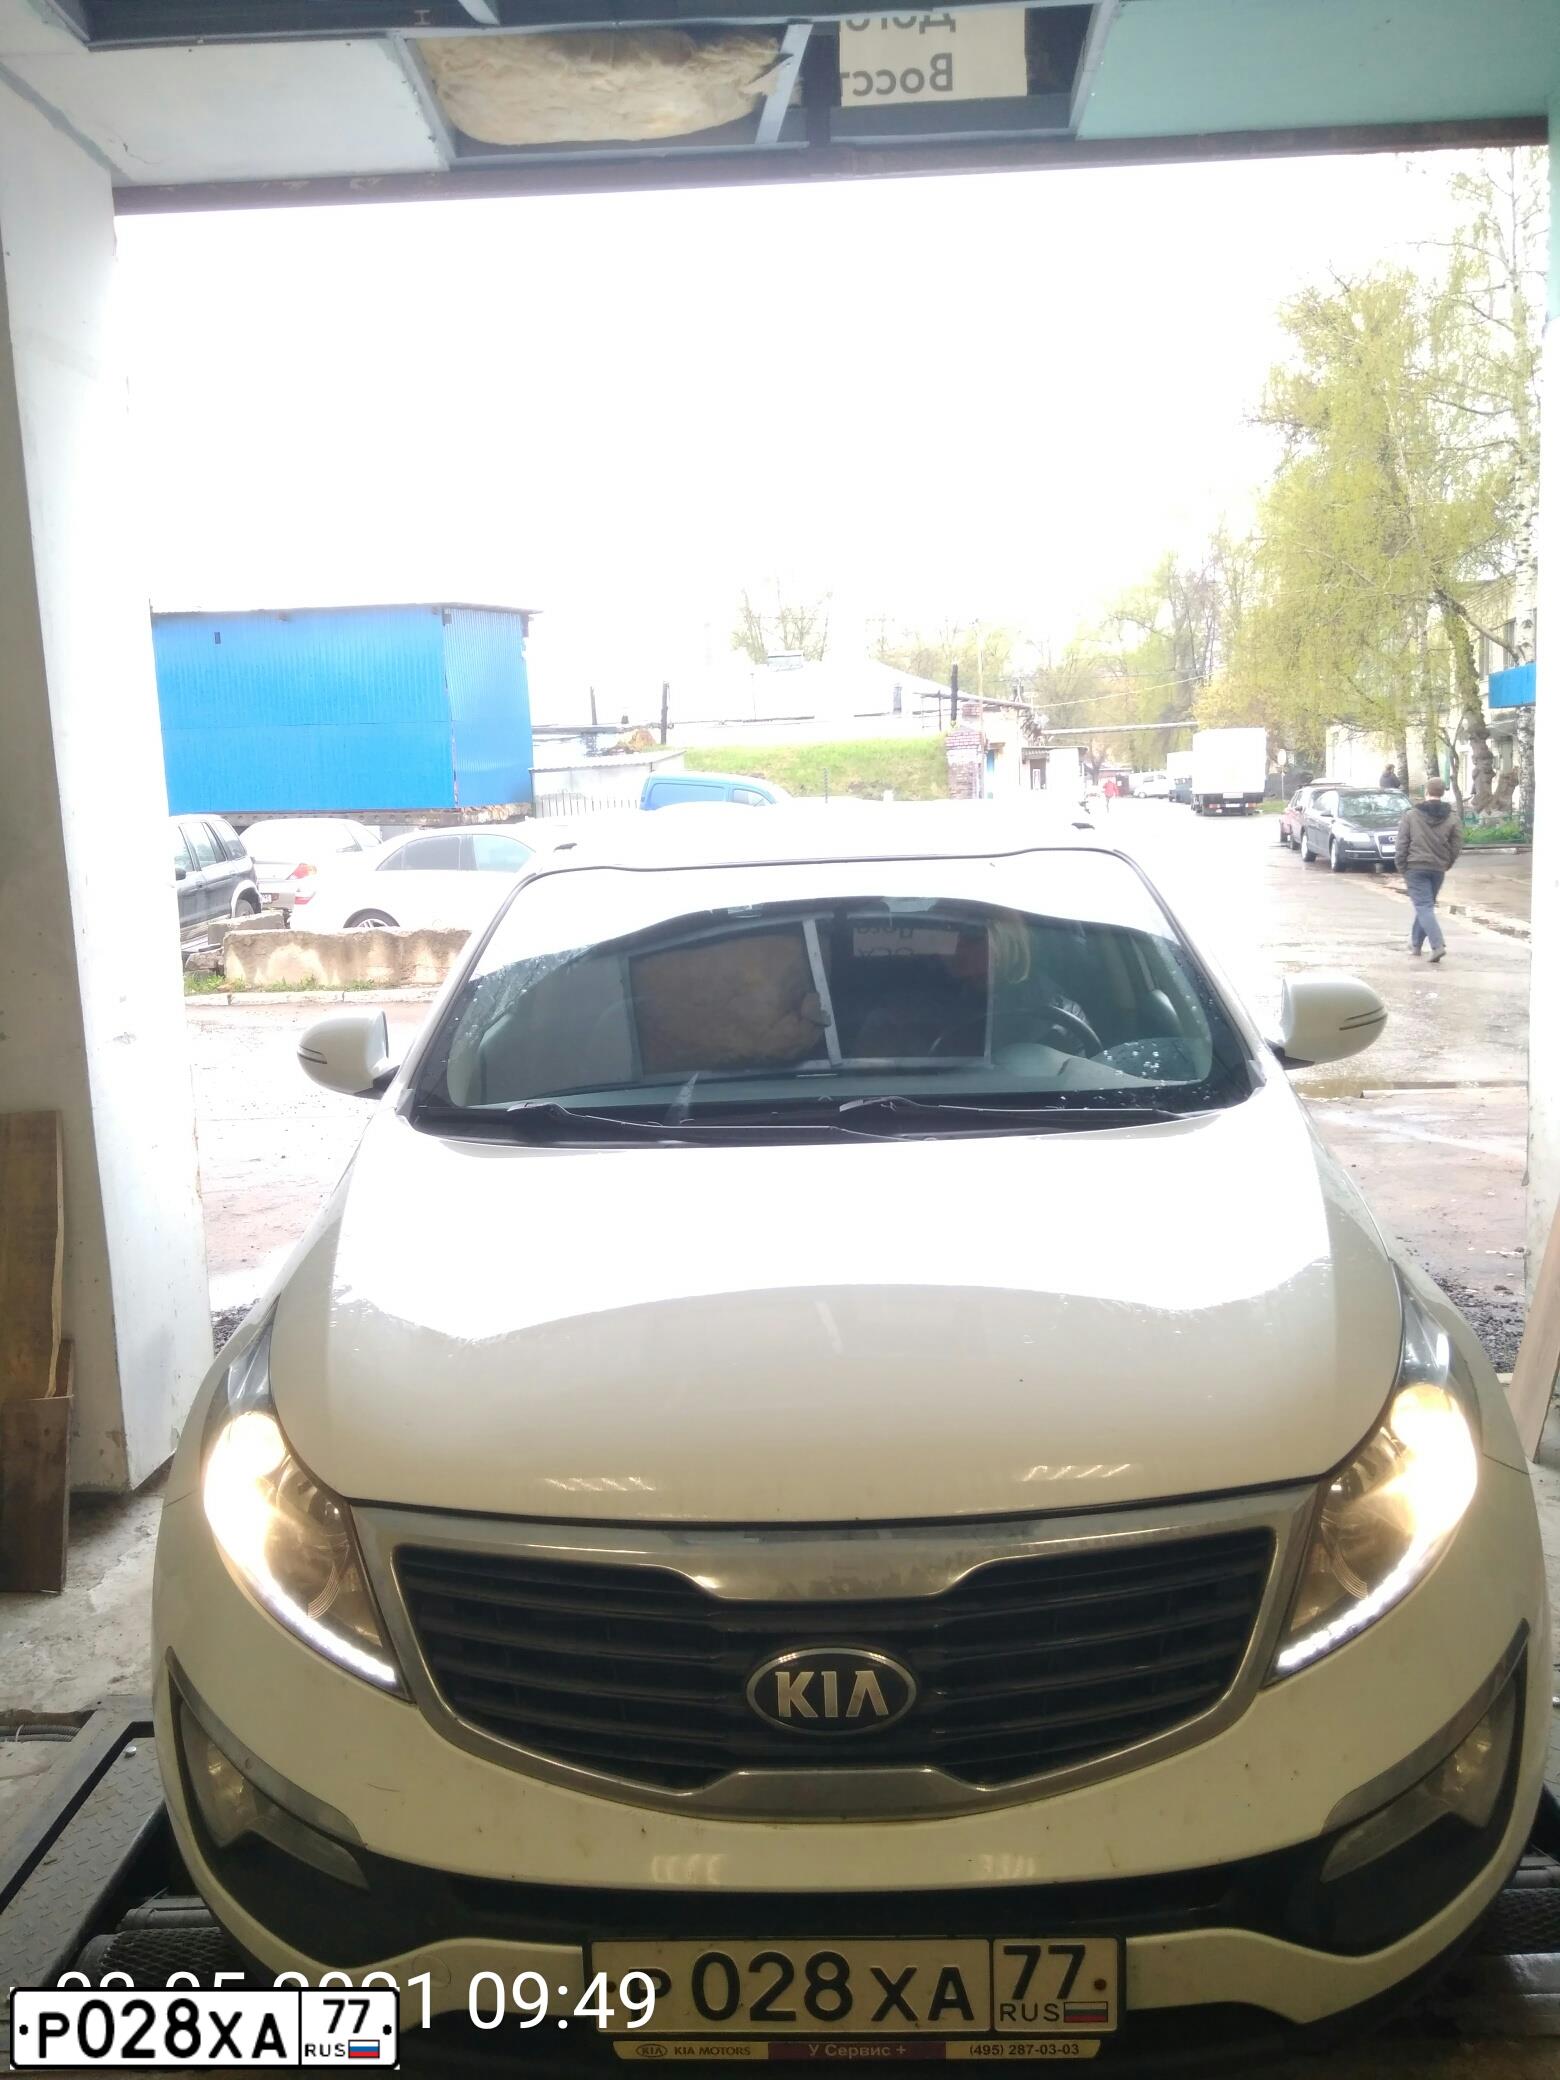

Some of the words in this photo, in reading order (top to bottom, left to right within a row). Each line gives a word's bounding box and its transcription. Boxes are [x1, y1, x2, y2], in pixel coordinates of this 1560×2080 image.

[775, 1670, 889, 1718] KIA
[1003, 1945, 1087, 2000] 77
[1000, 2003, 1059, 2022] RUS
[674, 2046, 696, 2056] KIA
[699, 2046, 751, 2056] MOTORS
[824, 2044, 890, 2059] Сервис
[969, 2045, 1003, 2057] (495)
[1008, 2043, 1080, 2056] 287-03-03
